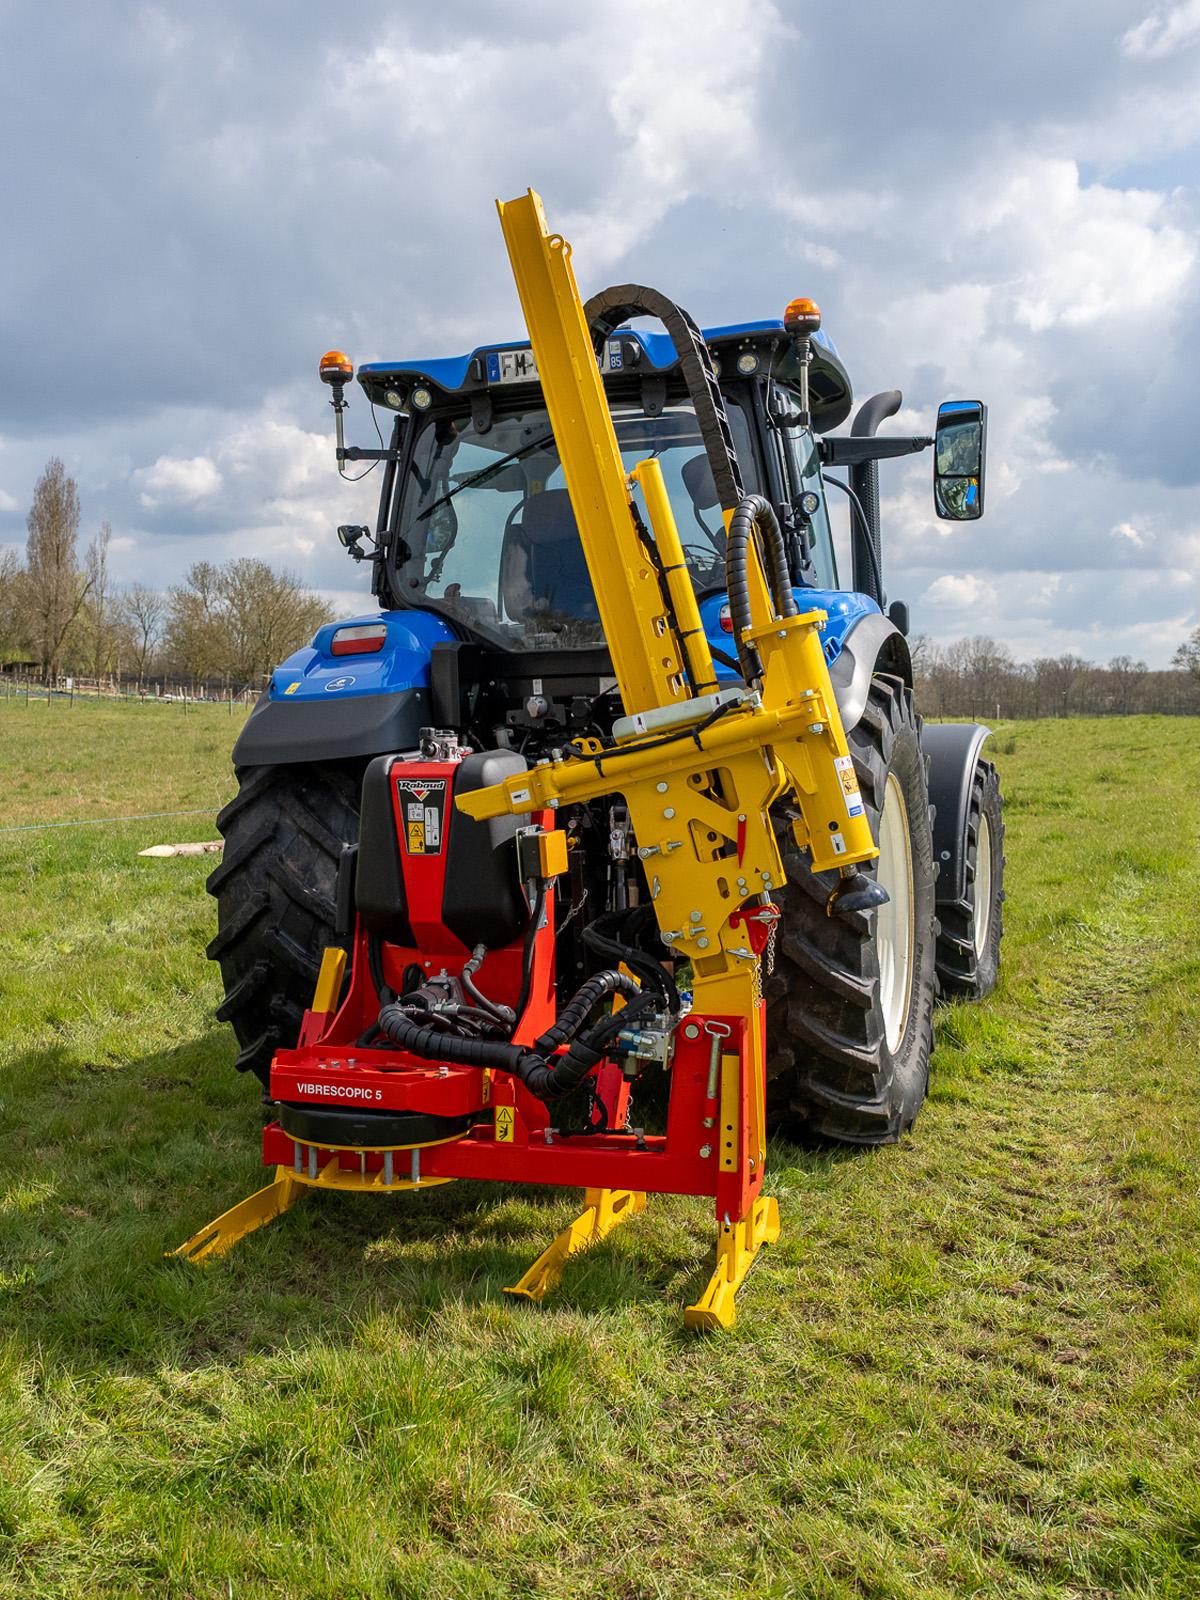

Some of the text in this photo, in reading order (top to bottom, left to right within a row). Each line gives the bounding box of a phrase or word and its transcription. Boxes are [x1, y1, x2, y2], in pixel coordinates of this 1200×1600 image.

[610, 356, 622, 368] 85
[400, 781, 446, 792] Rabaud
[297, 1082, 382, 1100] VIBRESCOPIC 5
